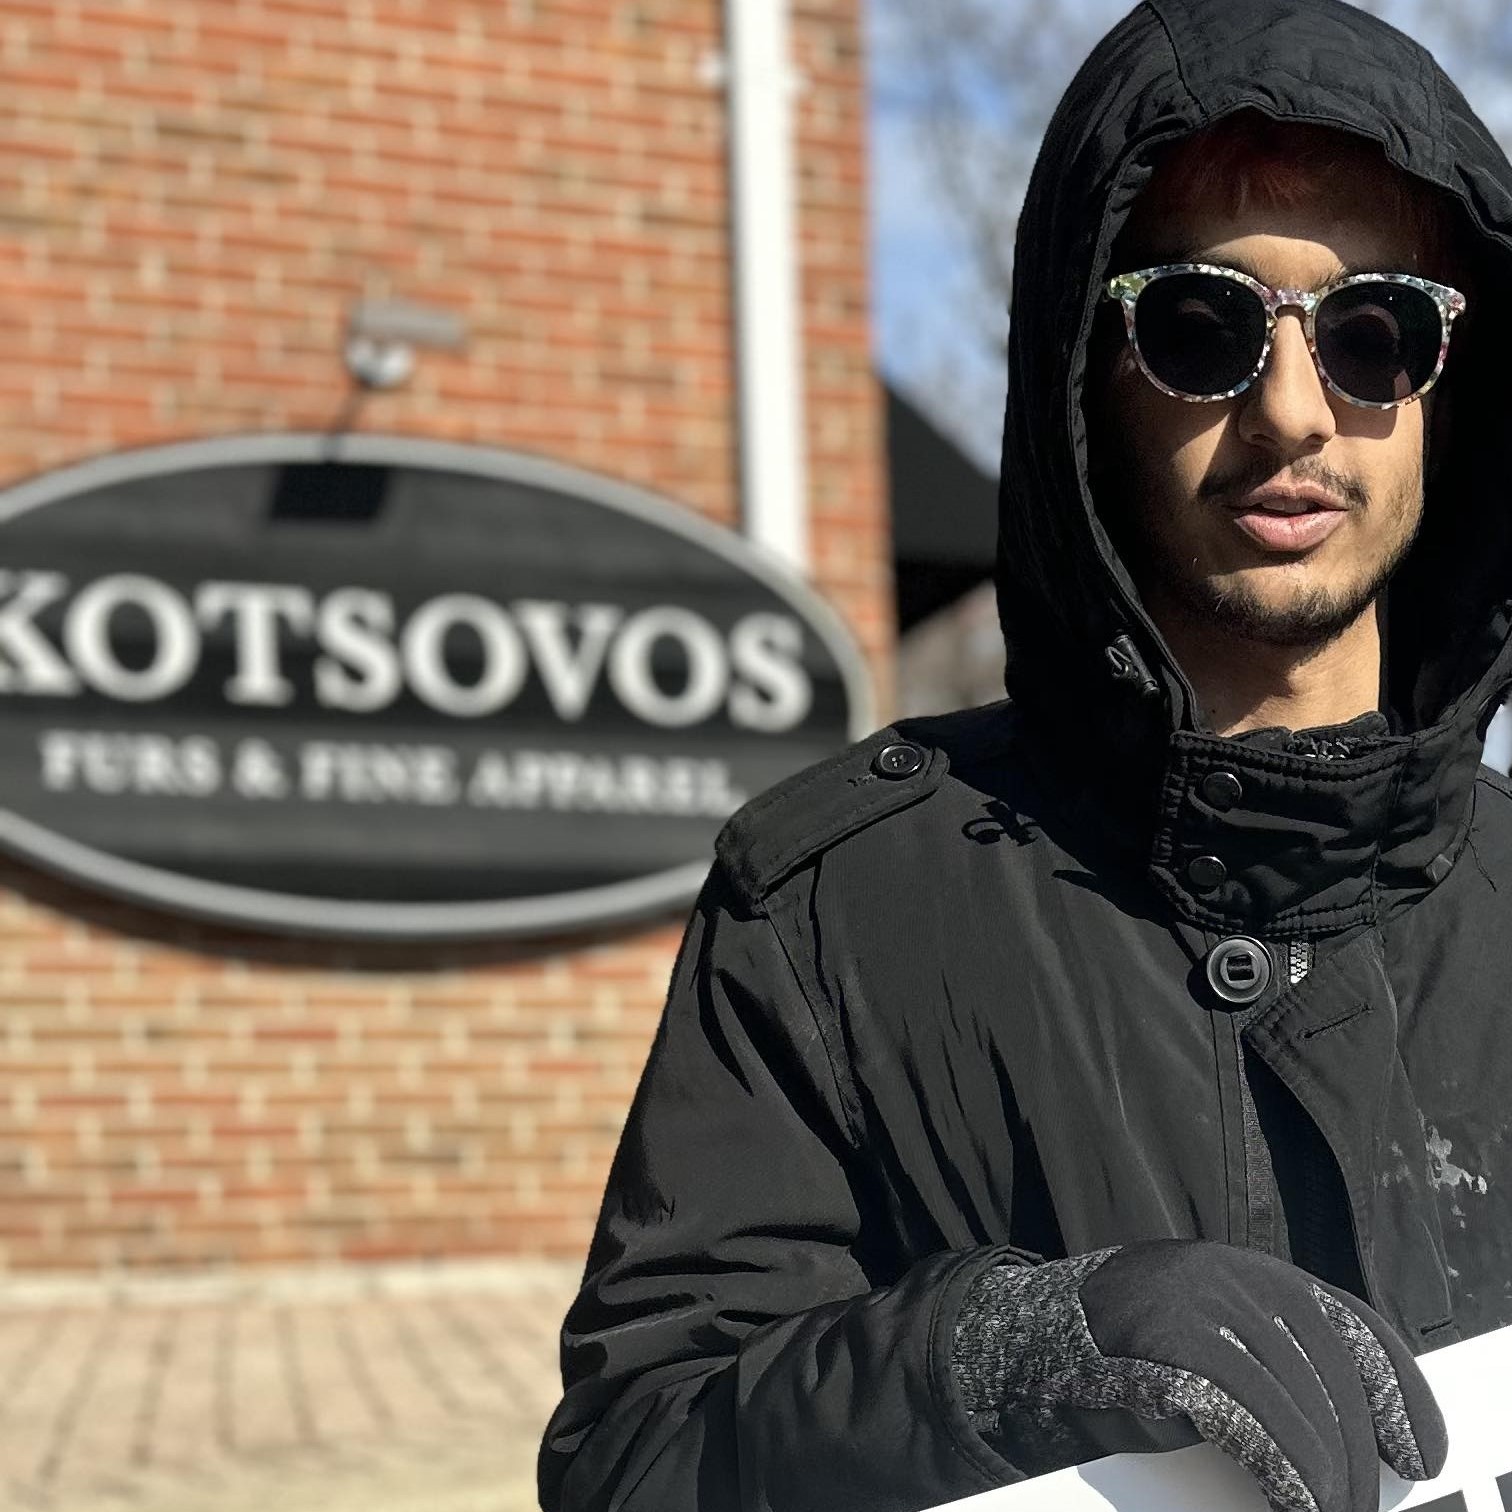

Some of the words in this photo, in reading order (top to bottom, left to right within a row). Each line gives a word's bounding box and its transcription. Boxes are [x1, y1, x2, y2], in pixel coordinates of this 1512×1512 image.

[0, 569, 814, 733] KOTSOVOS
[40, 729, 222, 799] FURS
[232, 738, 288, 800] &
[299, 740, 459, 806] FINE
[468, 748, 748, 818] APPAREL
